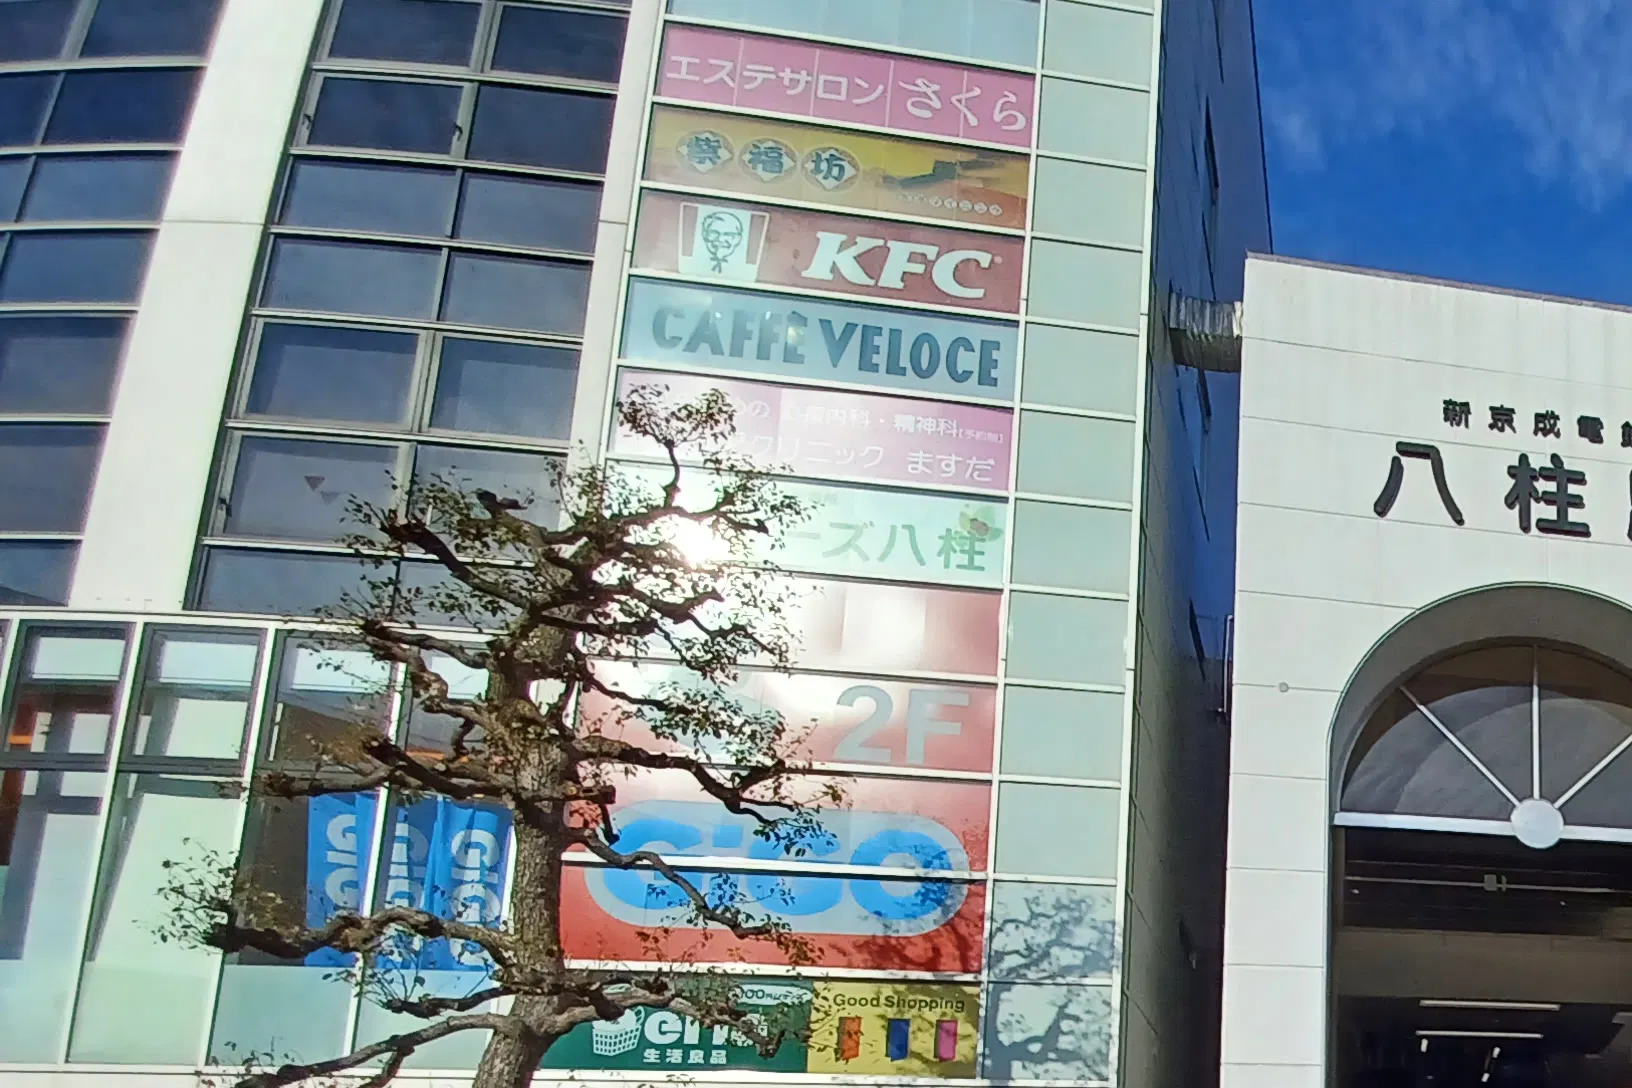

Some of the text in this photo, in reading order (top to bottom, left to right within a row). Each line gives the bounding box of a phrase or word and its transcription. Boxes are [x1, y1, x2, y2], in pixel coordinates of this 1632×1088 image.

[665, 54, 1029, 132] エステサロン さくら
[802, 231, 992, 299] KFC
[819, 318, 1001, 387] VELOCE
[907, 450, 995, 482] ますだ
[833, 684, 969, 767] 2F
[833, 993, 965, 1014] Good Shopping
[643, 1048, 727, 1065] 生活良品
